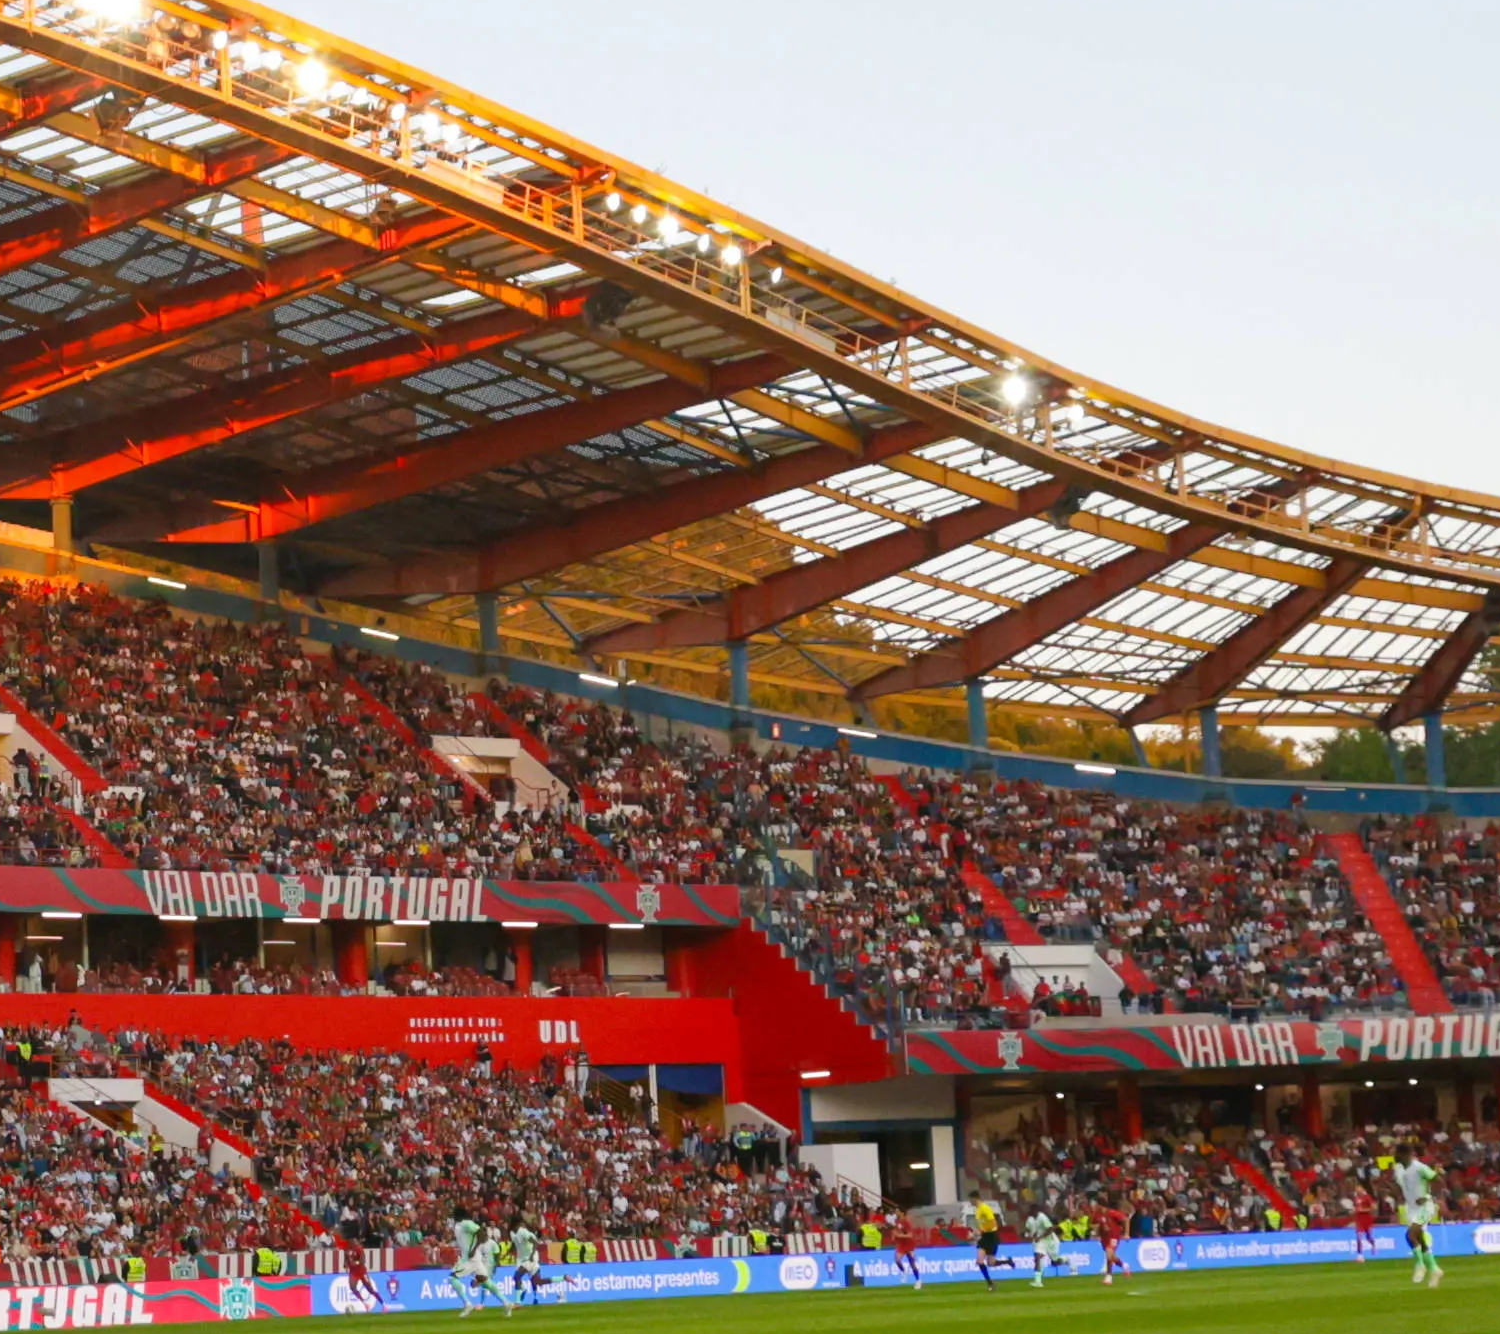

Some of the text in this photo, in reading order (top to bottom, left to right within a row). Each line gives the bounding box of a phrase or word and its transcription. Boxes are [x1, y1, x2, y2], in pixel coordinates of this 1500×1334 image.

[143, 869, 488, 921] VAI DAR PORTUGAL
[539, 1020, 580, 1044] UDL
[1172, 1023, 1225, 1067] VAI
[1230, 1022, 1299, 1066] DAR
[1197, 1245, 1204, 1258] A
[853, 1260, 862, 1276] A
[421, 1279, 432, 1299] A
[594, 1273, 651, 1292] estamos
[655, 1269, 719, 1293] presentes
